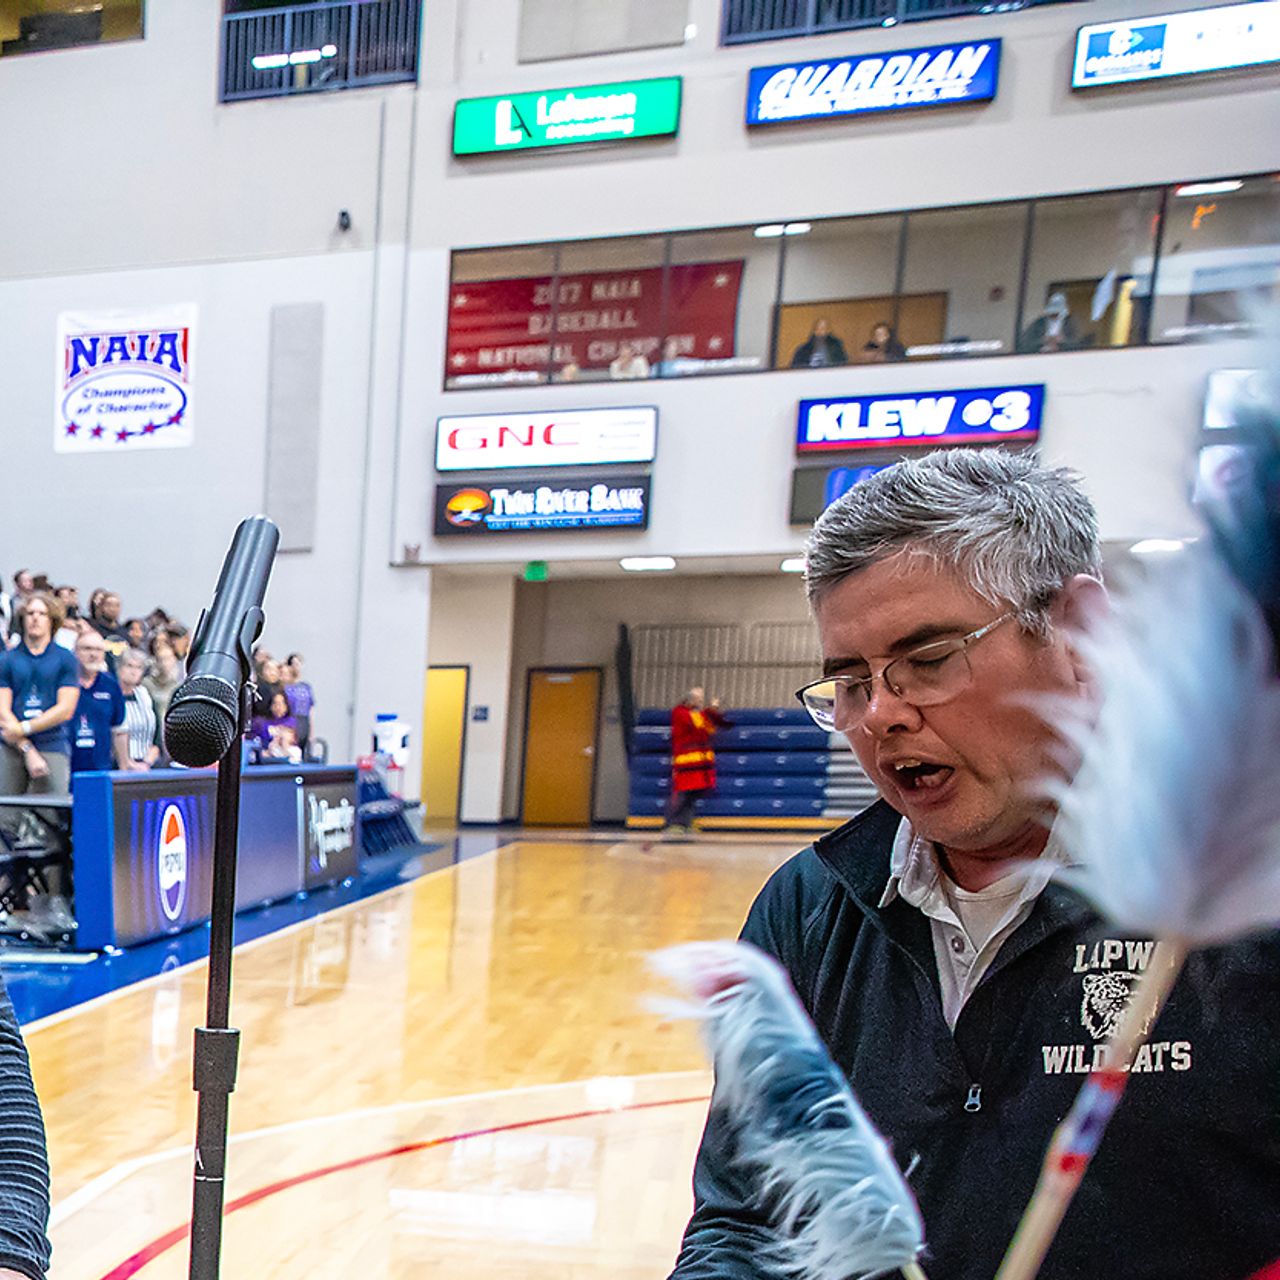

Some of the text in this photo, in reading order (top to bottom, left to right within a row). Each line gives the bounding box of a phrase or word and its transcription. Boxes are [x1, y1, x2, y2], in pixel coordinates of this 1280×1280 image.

[70, 333, 182, 377] NAIA
[806, 397, 957, 441] KLEW
[1042, 1041, 1192, 1074] WILDATS
